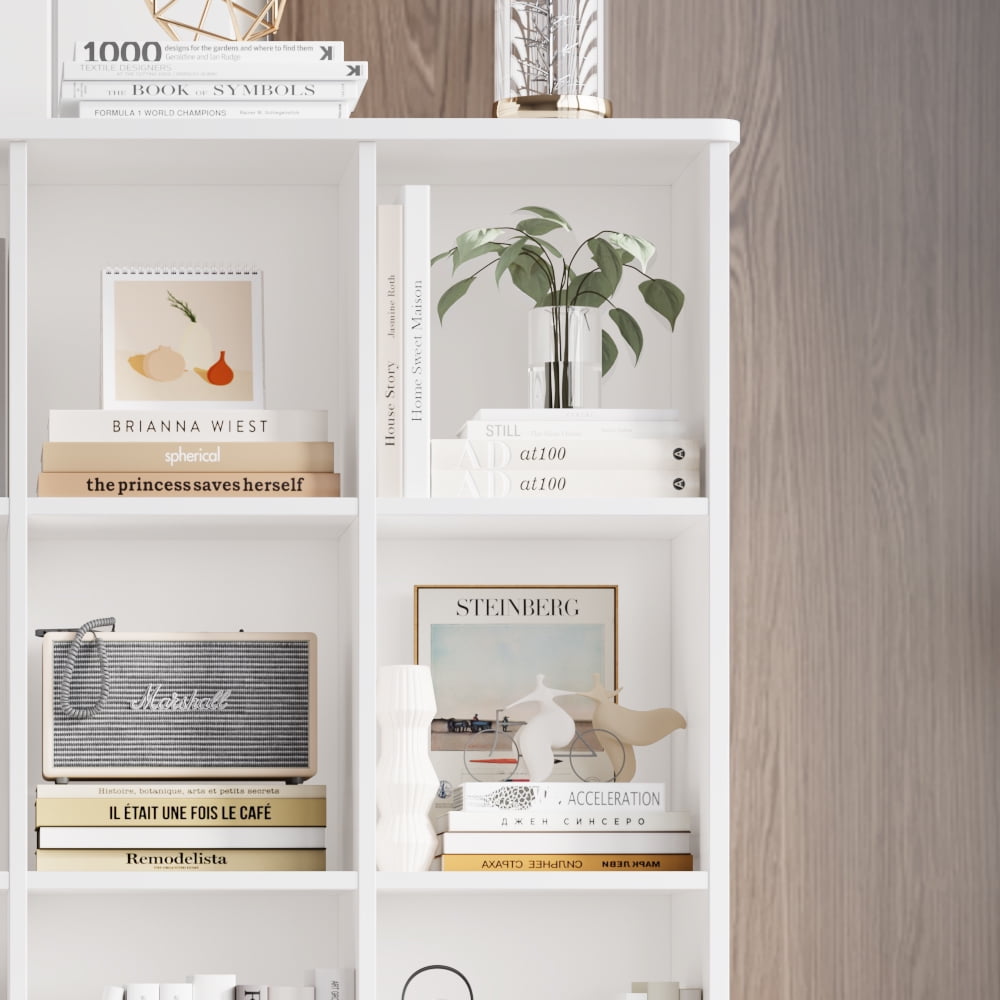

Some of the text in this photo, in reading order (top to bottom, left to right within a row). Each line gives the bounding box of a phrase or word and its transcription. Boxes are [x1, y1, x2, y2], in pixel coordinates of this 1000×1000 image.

[83, 41, 162, 62] 1000
[165, 45, 313, 53] designs for the gardens and where to find them
[132, 84, 189, 96] BOOK
[213, 84, 315, 96] SYMBOLS
[411, 280, 423, 422] Home Sweet Maison
[385, 361, 400, 446] House Story
[112, 420, 268, 433] BRIANNA WIEST
[486, 424, 520, 437] STILL
[164, 446, 221, 466] spherical
[87, 477, 304, 495] the princess saves herself
[456, 598, 580, 617] STEINBERG
[130, 682, 232, 711] Marshall
[98, 788, 280, 796] Histoire, botanique, arts et petits secrets
[568, 791, 661, 806] ACCELERATION
[110, 802, 272, 819] IL ÉTAIT UNE FOIS LE CAFÉ
[501, 817, 646, 826] ДЖЕН СИНСЕРО
[126, 852, 228, 865] Remodelista
